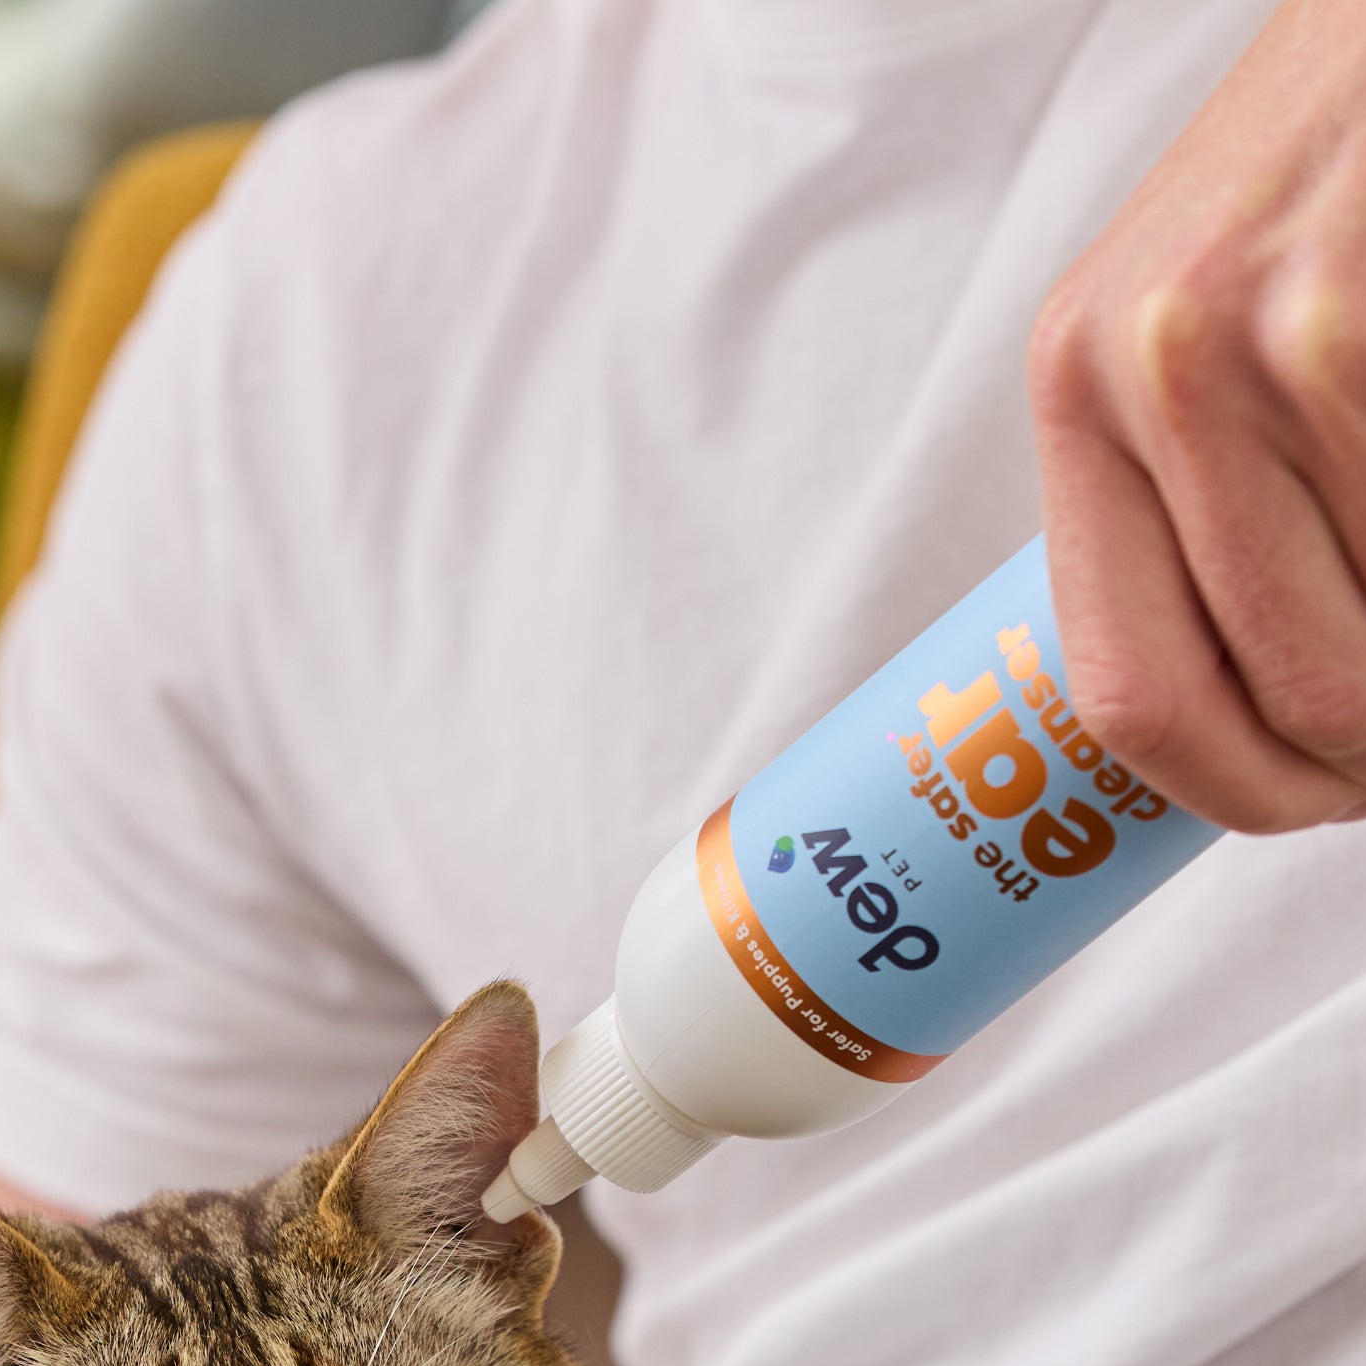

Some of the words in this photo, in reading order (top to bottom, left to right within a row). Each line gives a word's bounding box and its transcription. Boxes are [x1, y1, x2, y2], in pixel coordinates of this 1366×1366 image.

[995, 622, 1170, 823] cleanser
[897, 731, 979, 842] safer
[916, 669, 1117, 878] ear
[801, 828, 940, 973] dew
[880, 848, 923, 892] PET
[973, 841, 1040, 903] the
[735, 922, 750, 941] &
[746, 939, 804, 1011] Puppies
[800, 1008, 828, 1033] for
[826, 1030, 873, 1062] Safer
